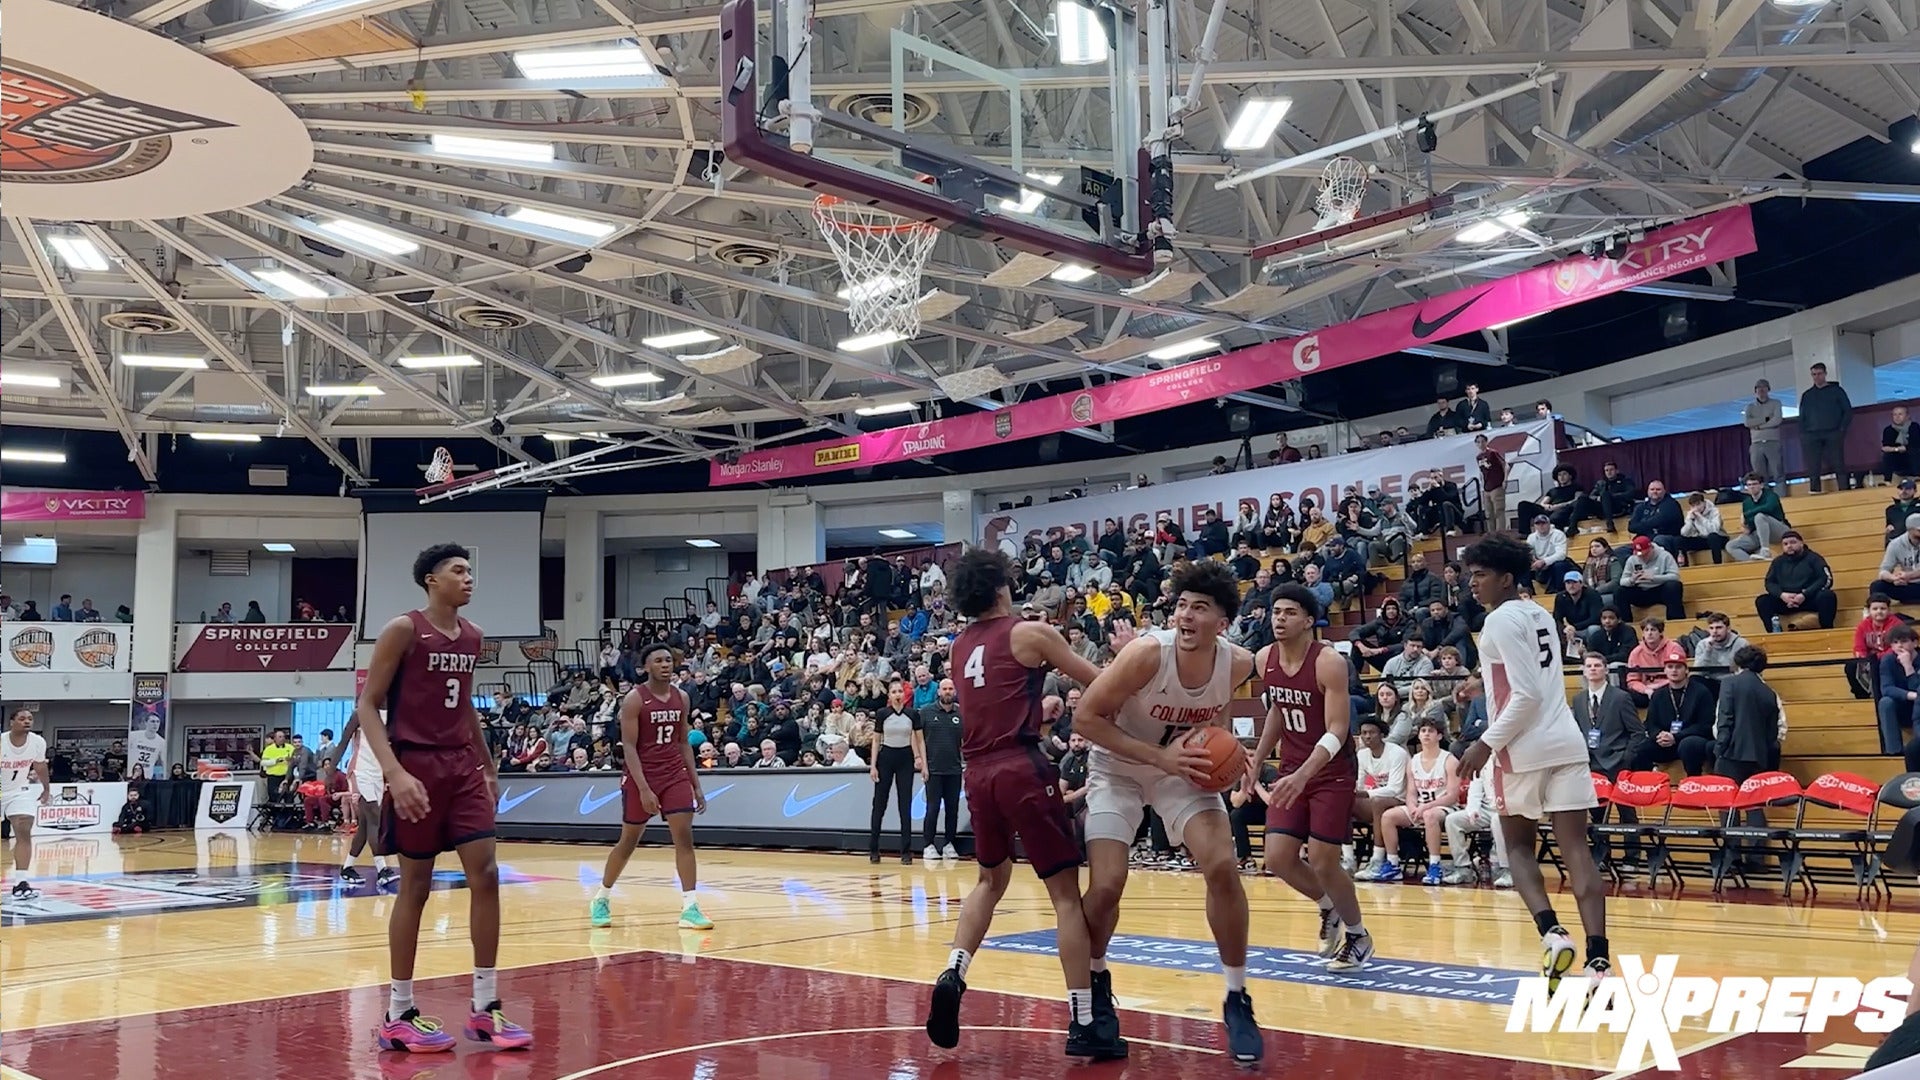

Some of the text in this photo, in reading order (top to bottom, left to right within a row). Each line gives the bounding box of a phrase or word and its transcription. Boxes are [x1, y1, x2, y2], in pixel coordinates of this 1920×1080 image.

[20, 97, 206, 147] FAME
[1667, 252, 1707, 272] INSOLES
[1293, 335, 1320, 372] G
[1149, 362, 1221, 387] SPRINGFIELD
[1166, 378, 1204, 391] COLLEGE
[816, 447, 858, 463] PANINI
[902, 434, 945, 456] SPALDING
[720, 457, 784, 478] Morgan Stanley
[205, 628, 329, 640] SPRINGFIELD
[235, 643, 298, 651] COLLEGE
[1536, 628, 1553, 669] 5
[427, 652, 476, 673] PERRY
[963, 644, 986, 689] 4
[444, 678, 461, 709] 3
[1268, 685, 1312, 707] PERRY
[650, 709, 681, 724] PERRY
[1281, 707, 1307, 733] 10
[656, 725, 675, 745] 13
[138, 751, 152, 763] 32
[12, 770, 19, 781] 1
[214, 792, 238, 800] ARMY
[41, 806, 98, 820] HOOPHALL
[211, 804, 236, 812] GUARD
